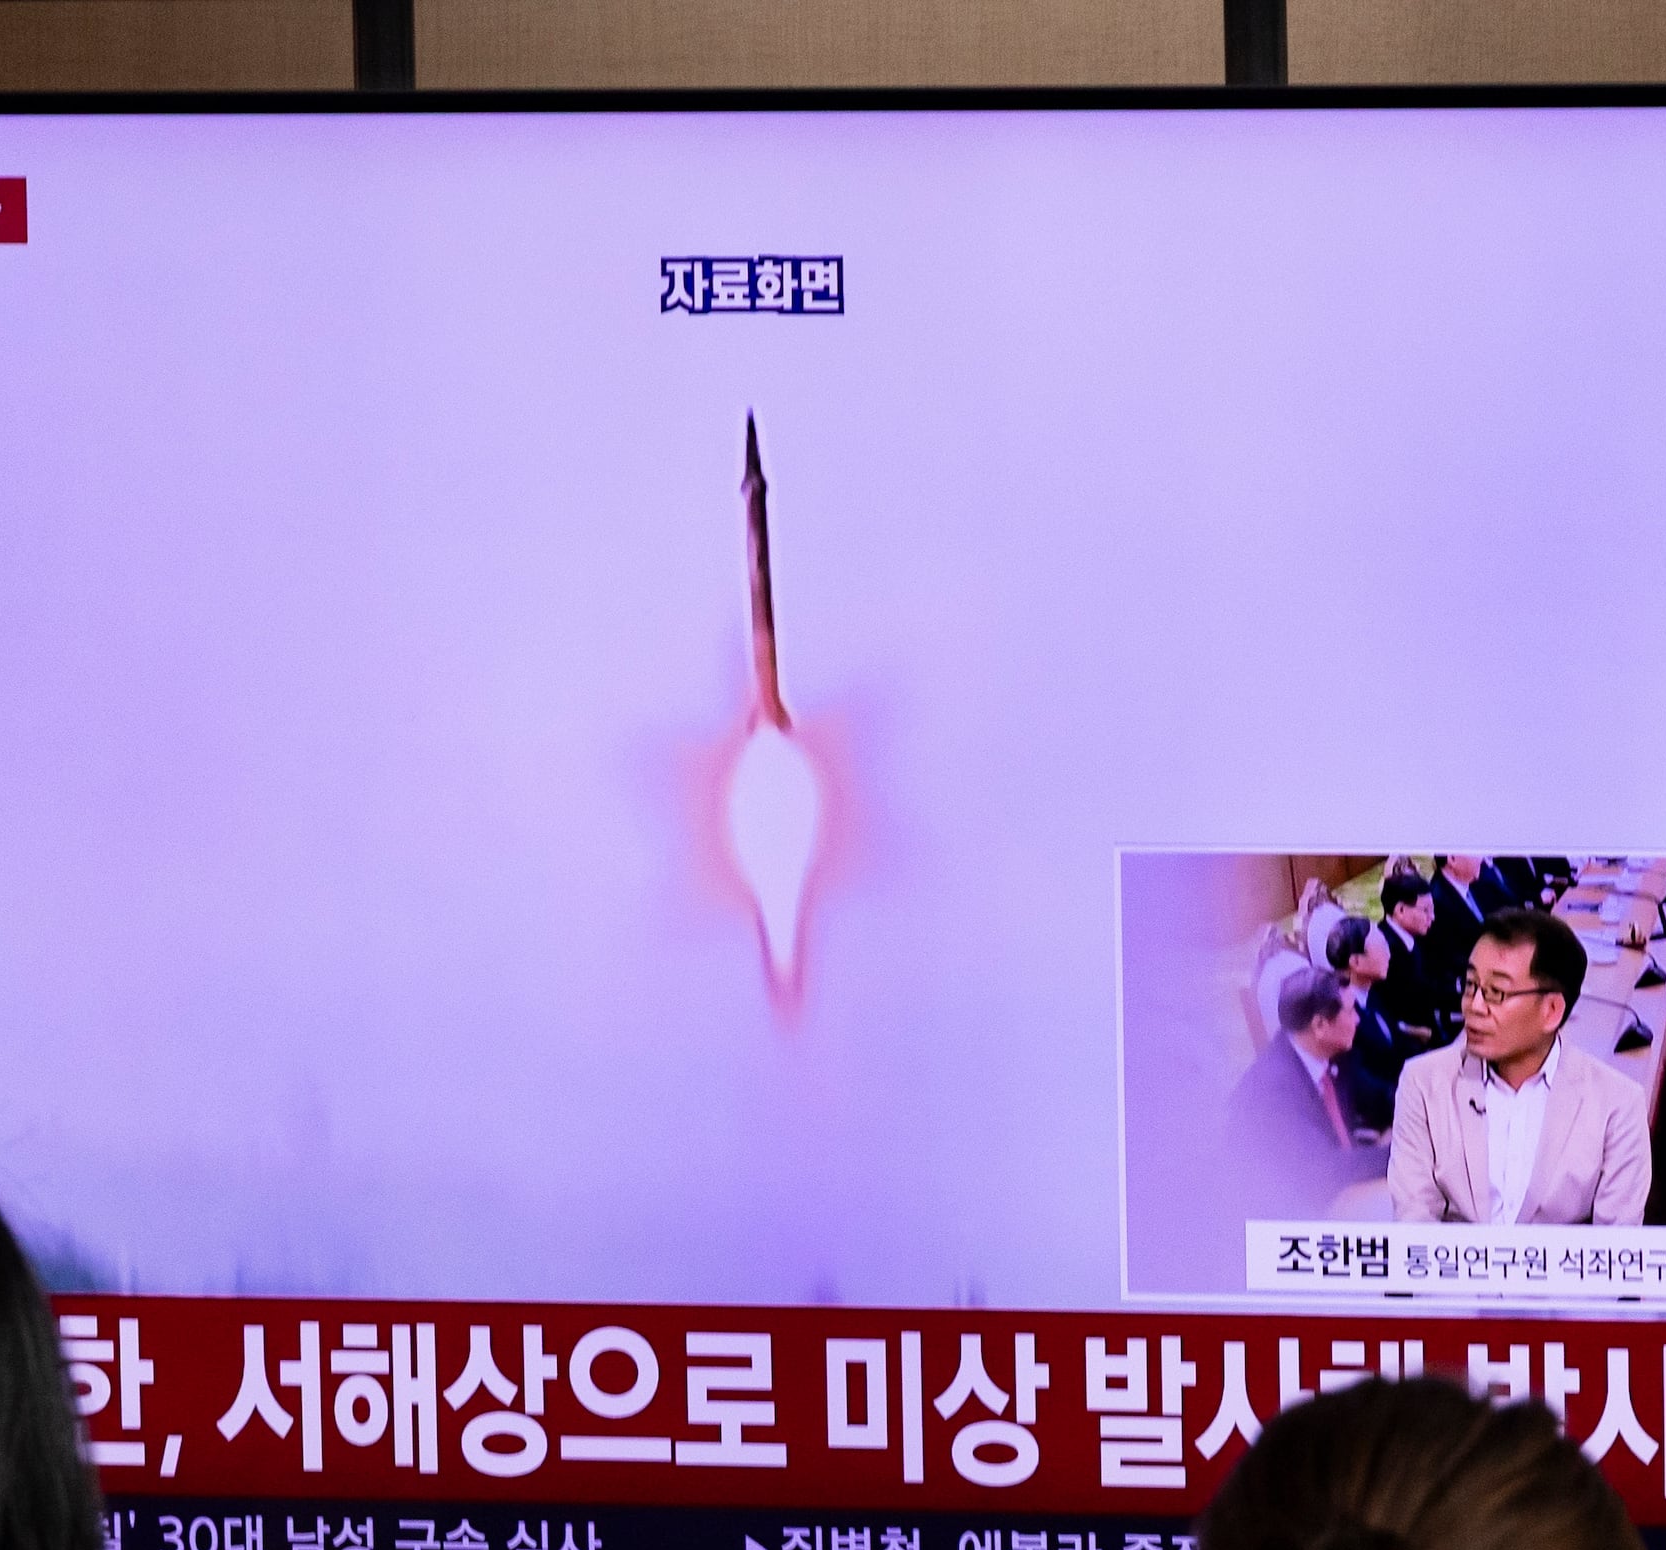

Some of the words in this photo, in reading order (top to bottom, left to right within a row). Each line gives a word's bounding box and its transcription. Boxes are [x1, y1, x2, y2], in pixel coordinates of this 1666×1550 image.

[661, 257, 843, 313] 자료화면
[1276, 1234, 1391, 1279] 조한범
[1403, 1244, 1549, 1282] 통일연구원
[216, 1320, 788, 1478] 서해상으로
[825, 1330, 1050, 1487] 미상
